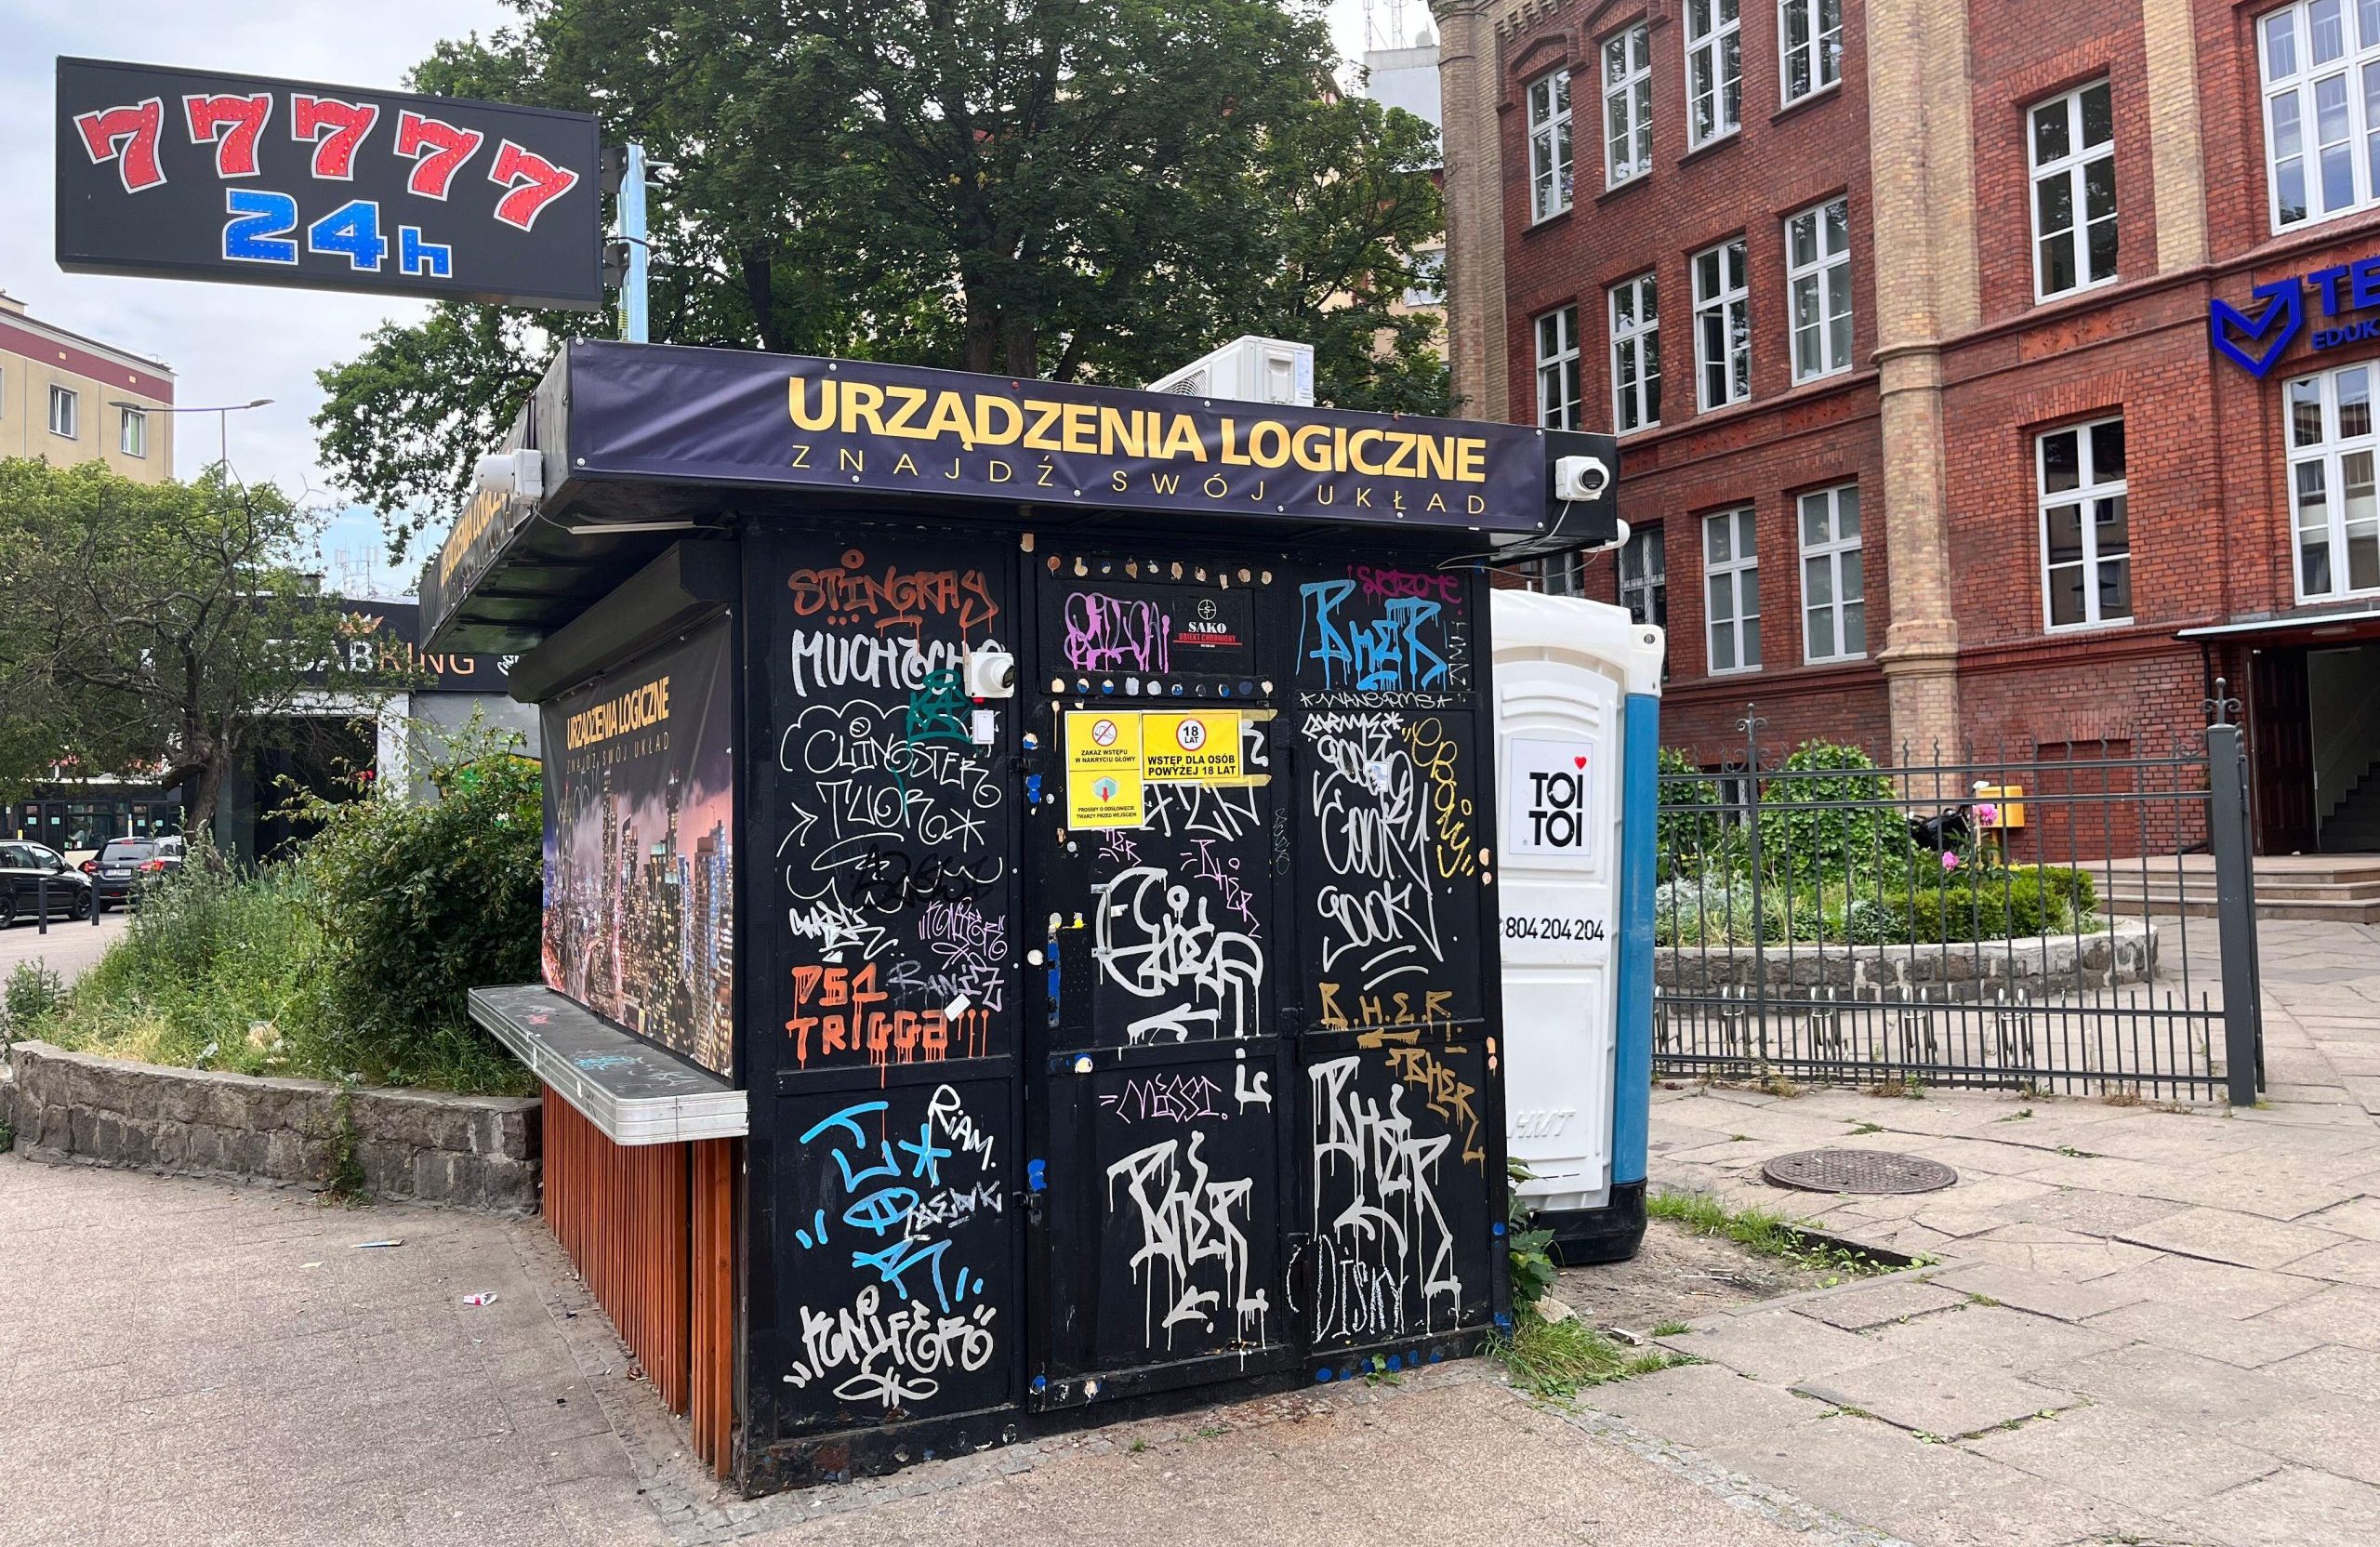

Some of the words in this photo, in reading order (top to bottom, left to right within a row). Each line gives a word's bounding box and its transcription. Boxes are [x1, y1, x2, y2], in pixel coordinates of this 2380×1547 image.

[222, 188, 452, 279] 24h
[788, 376, 1208, 463] URZĄDZENIA
[1221, 417, 1487, 483] LOGICZNE
[791, 443, 1053, 487] ZNAJDŹ
[1112, 469, 1265, 502] SWÓJ
[1318, 484, 1486, 515] UKŁAD
[1188, 621, 1227, 634] SAKO
[567, 700, 617, 750] URZĄDZENIA
[618, 676, 669, 733] LOGICZNE
[1183, 725, 1199, 736] 18
[602, 743, 628, 766] SWÓJ
[634, 732, 669, 759] UKŁAD
[1147, 756, 1183, 767] WSTĘP
[1186, 755, 1205, 764] DLA
[1208, 753, 1236, 763] OSÓB
[1148, 764, 1198, 775] POWYŻEJ
[1202, 766, 1214, 774] 18
[1217, 765, 1236, 774] LAT
[1528, 772, 1584, 810] TOI
[1527, 810, 1583, 848] TOI
[1505, 917, 1539, 939] 804
[1540, 918, 1572, 940] 204
[1574, 919, 1605, 941] 204
